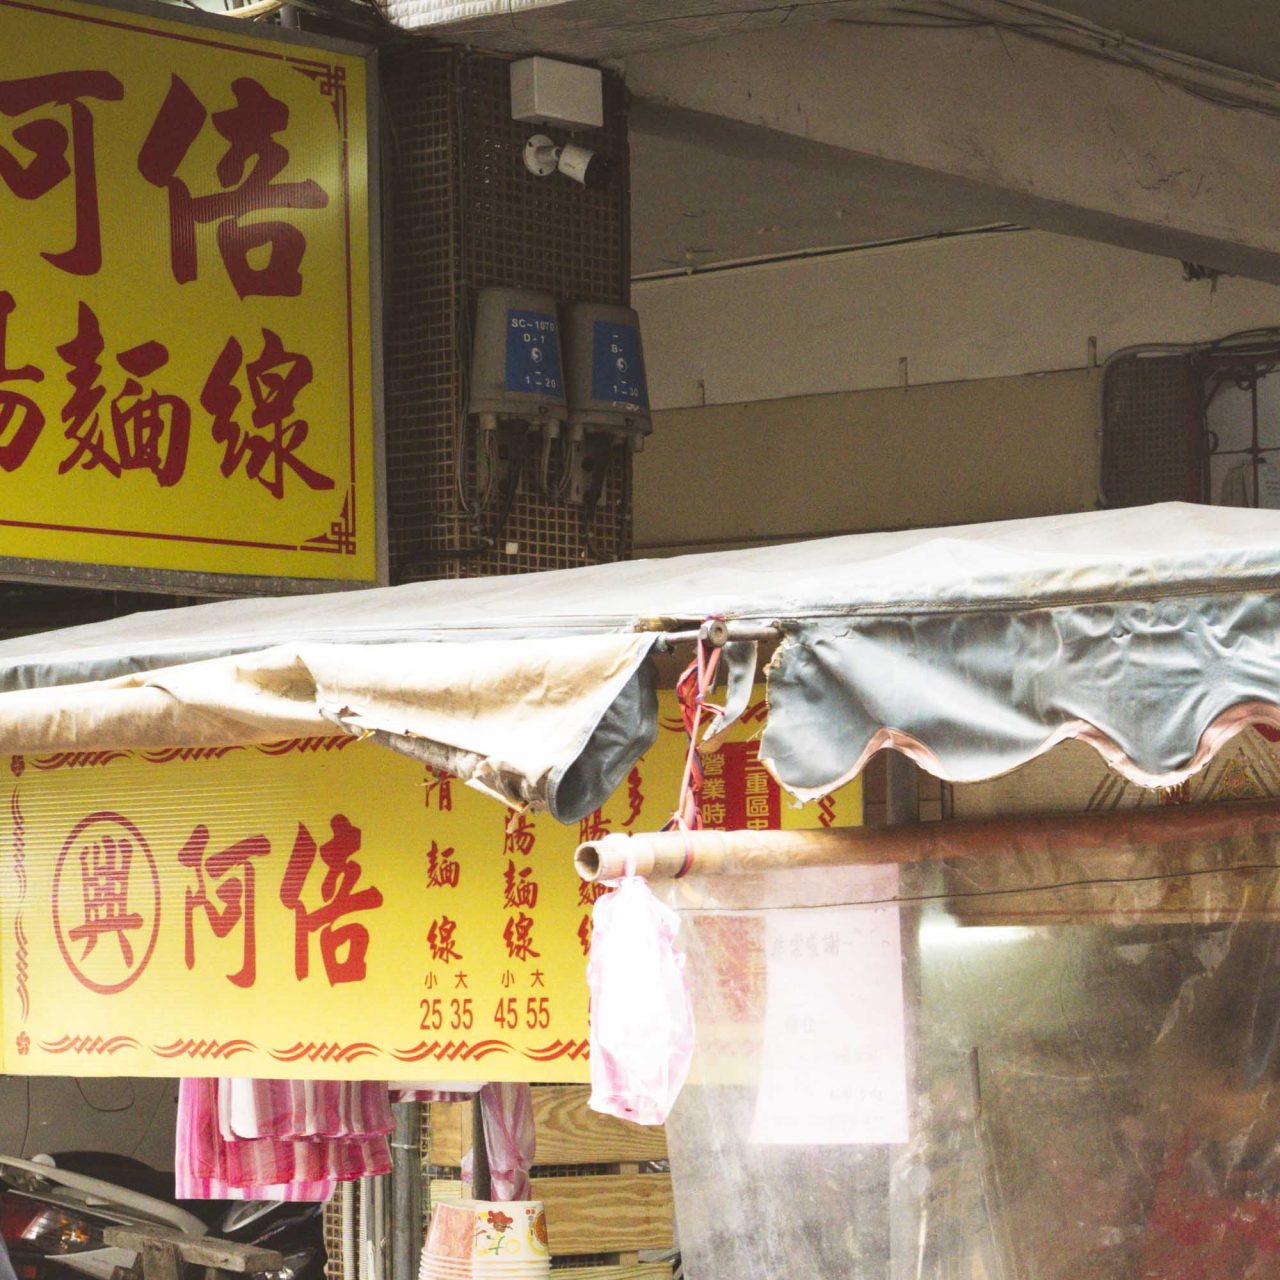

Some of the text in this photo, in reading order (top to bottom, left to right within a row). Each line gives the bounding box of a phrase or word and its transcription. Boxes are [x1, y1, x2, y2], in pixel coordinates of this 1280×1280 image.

[424, 970, 469, 989] 小 大
[501, 969, 545, 988] 小 大
[419, 998, 474, 1031] 25 35
[493, 997, 550, 1030] 45 55
